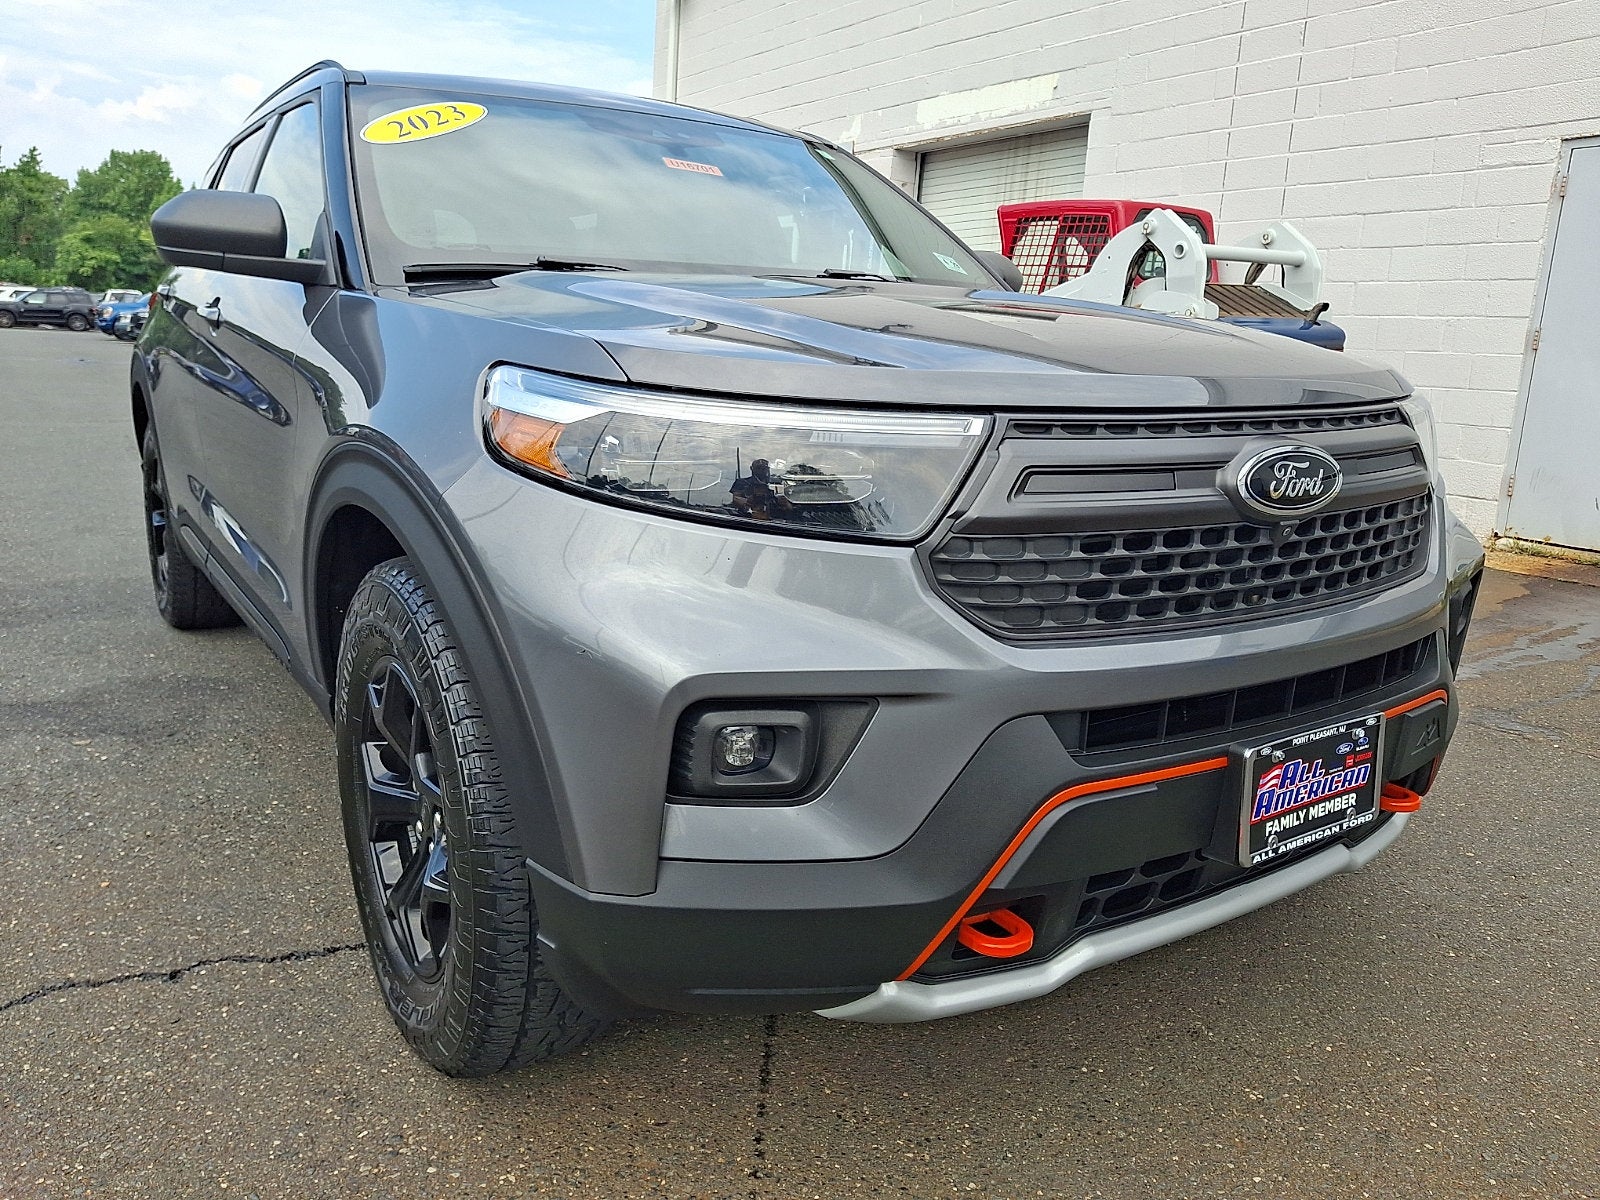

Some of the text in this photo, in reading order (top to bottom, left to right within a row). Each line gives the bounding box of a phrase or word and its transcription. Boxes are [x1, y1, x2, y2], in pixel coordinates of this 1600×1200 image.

[387, 105, 466, 138] 2023
[1269, 461, 1325, 500] Ford
[1292, 734, 1310, 747] POINT
[1265, 793, 1357, 837] FAMILY MEMBER
[1253, 813, 1374, 864] ALL AMERICAN FORD
